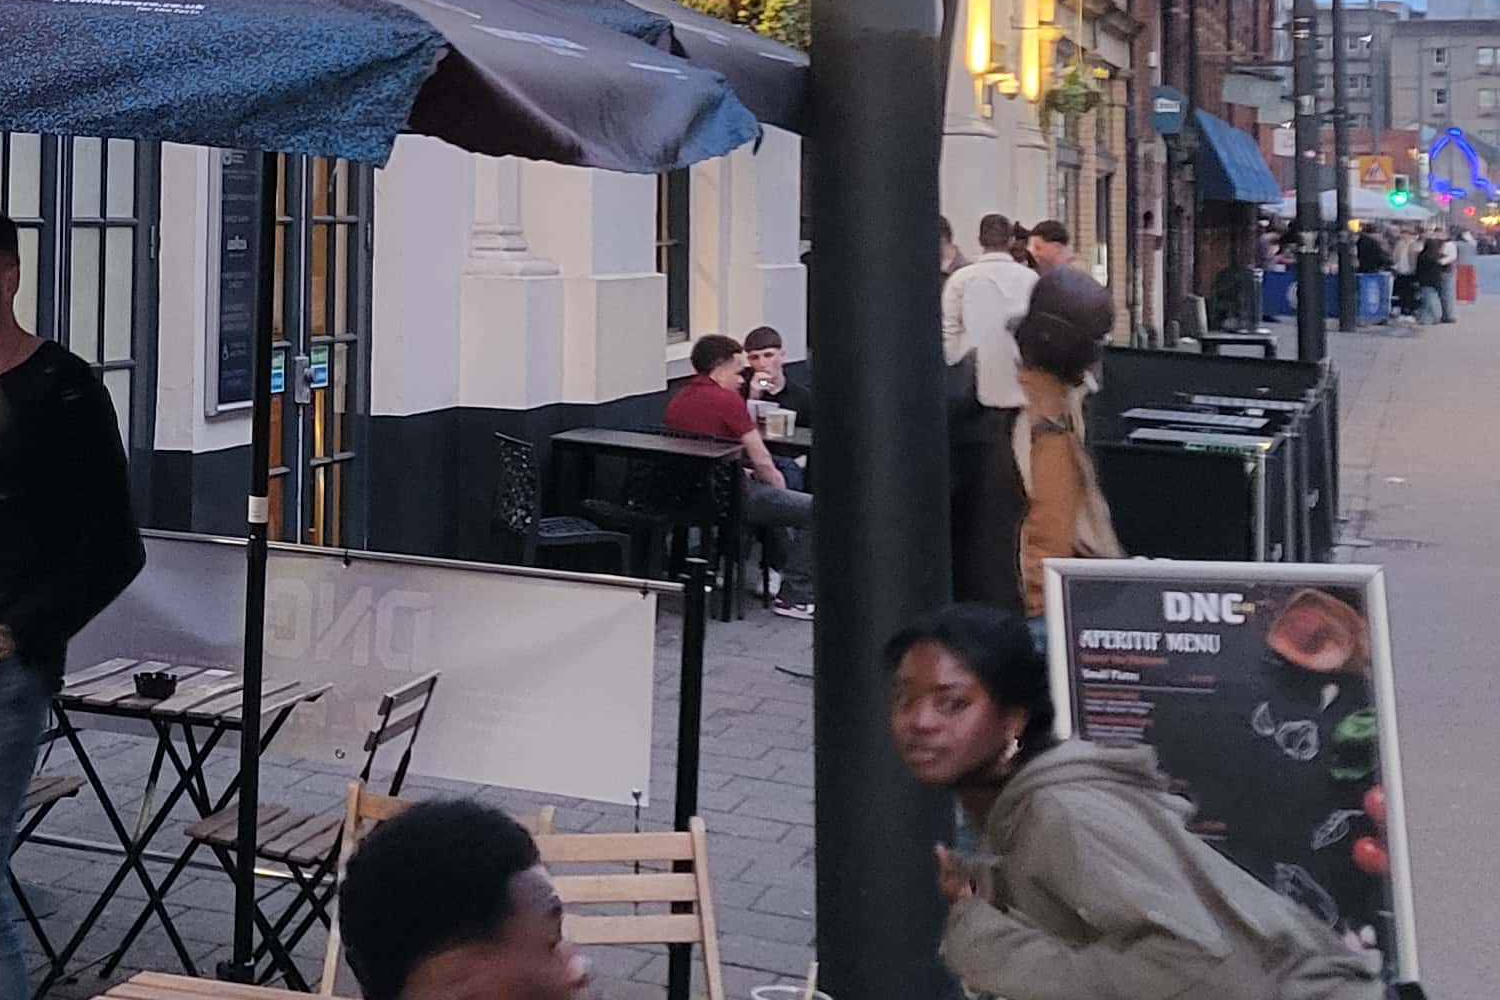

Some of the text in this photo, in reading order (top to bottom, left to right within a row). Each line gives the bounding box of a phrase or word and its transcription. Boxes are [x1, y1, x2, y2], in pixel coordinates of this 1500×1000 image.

[1162, 590, 1246, 624] DNC
[1079, 629, 1221, 654] APERITIF MENU
